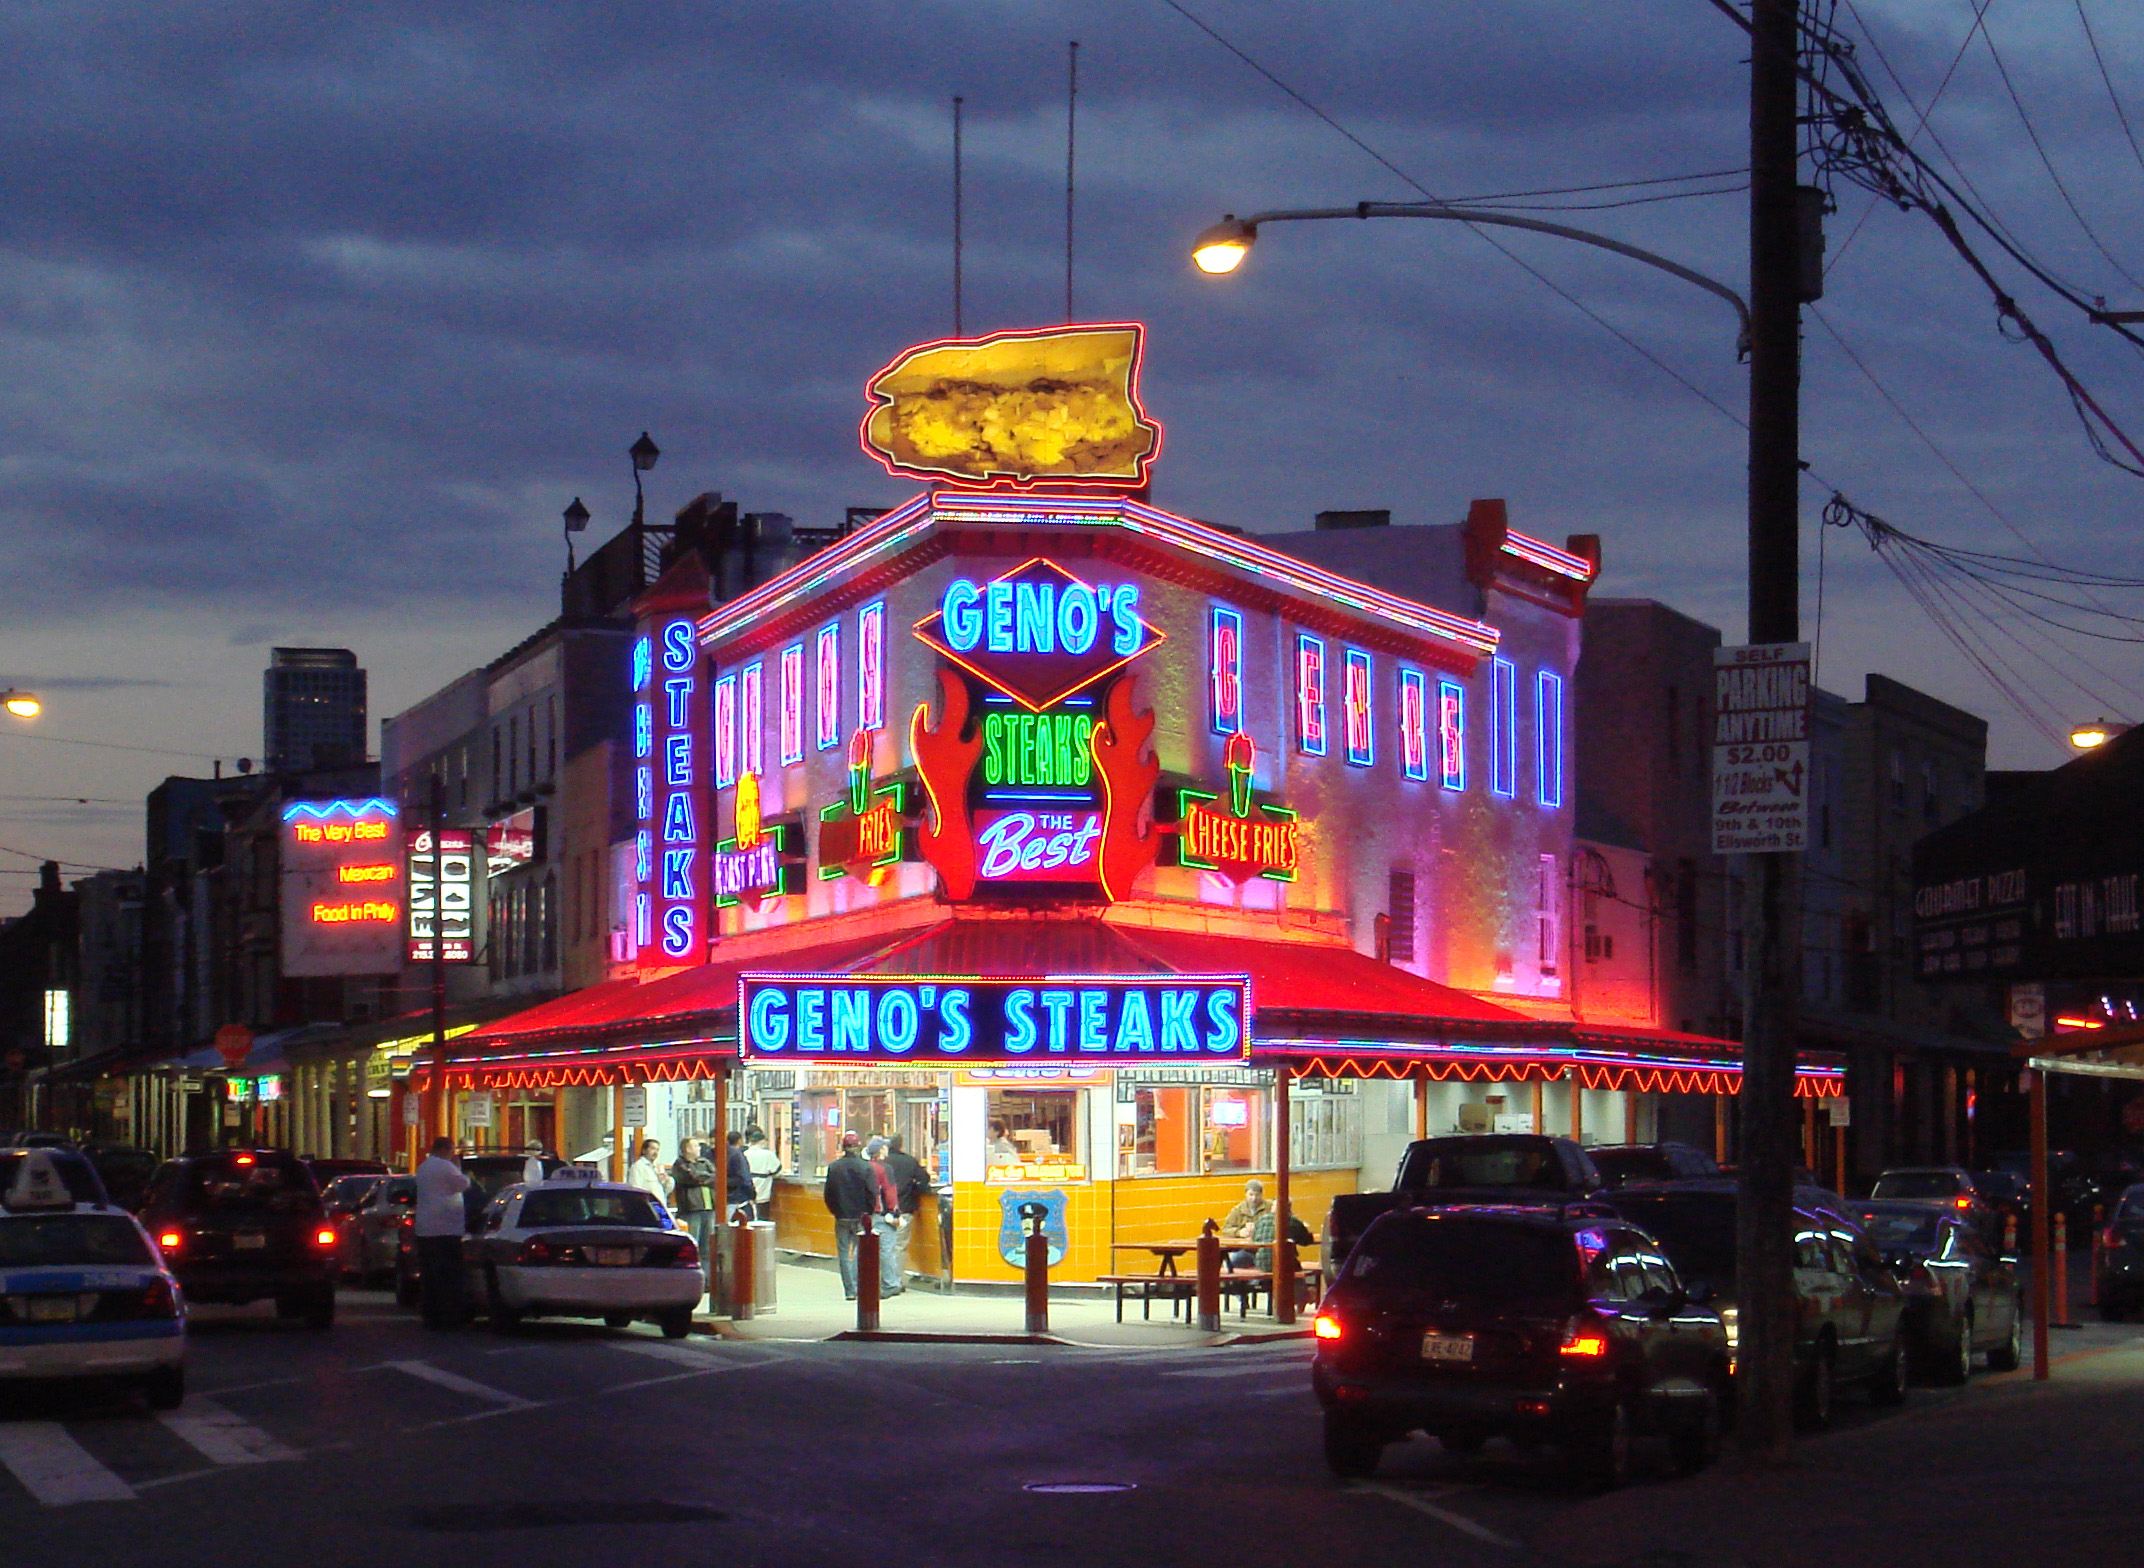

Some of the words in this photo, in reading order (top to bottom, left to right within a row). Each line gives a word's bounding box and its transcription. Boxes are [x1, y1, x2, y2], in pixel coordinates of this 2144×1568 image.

[942, 578, 1143, 656] GENO'S
[1736, 648, 1784, 663] SELF
[1716, 664, 1807, 711] PARKING
[1716, 709, 1805, 742] ANYTIME
[985, 713, 1092, 787] STEAKS
[1727, 743, 1790, 764] $2.00
[661, 619, 693, 957] STEAKS
[1718, 800, 1800, 815] Between
[294, 823, 322, 842] The
[322, 823, 353, 843] Very
[354, 820, 387, 840] Best
[859, 800, 893, 855] FRIES
[979, 811, 1101, 878] Best
[1040, 814, 1073, 830] THE
[1188, 803, 1249, 864] CHEESE
[1253, 820, 1297, 869] FRIES
[338, 865, 395, 883] Mexican
[1915, 878, 1981, 918] GOURMET
[1988, 868, 2026, 907] PIZZA
[313, 904, 348, 922] Food
[349, 904, 362, 921] in
[363, 902, 396, 922] Philly
[748, 985, 972, 1053] GENO'S
[1003, 987, 1239, 1053] STEAKS
